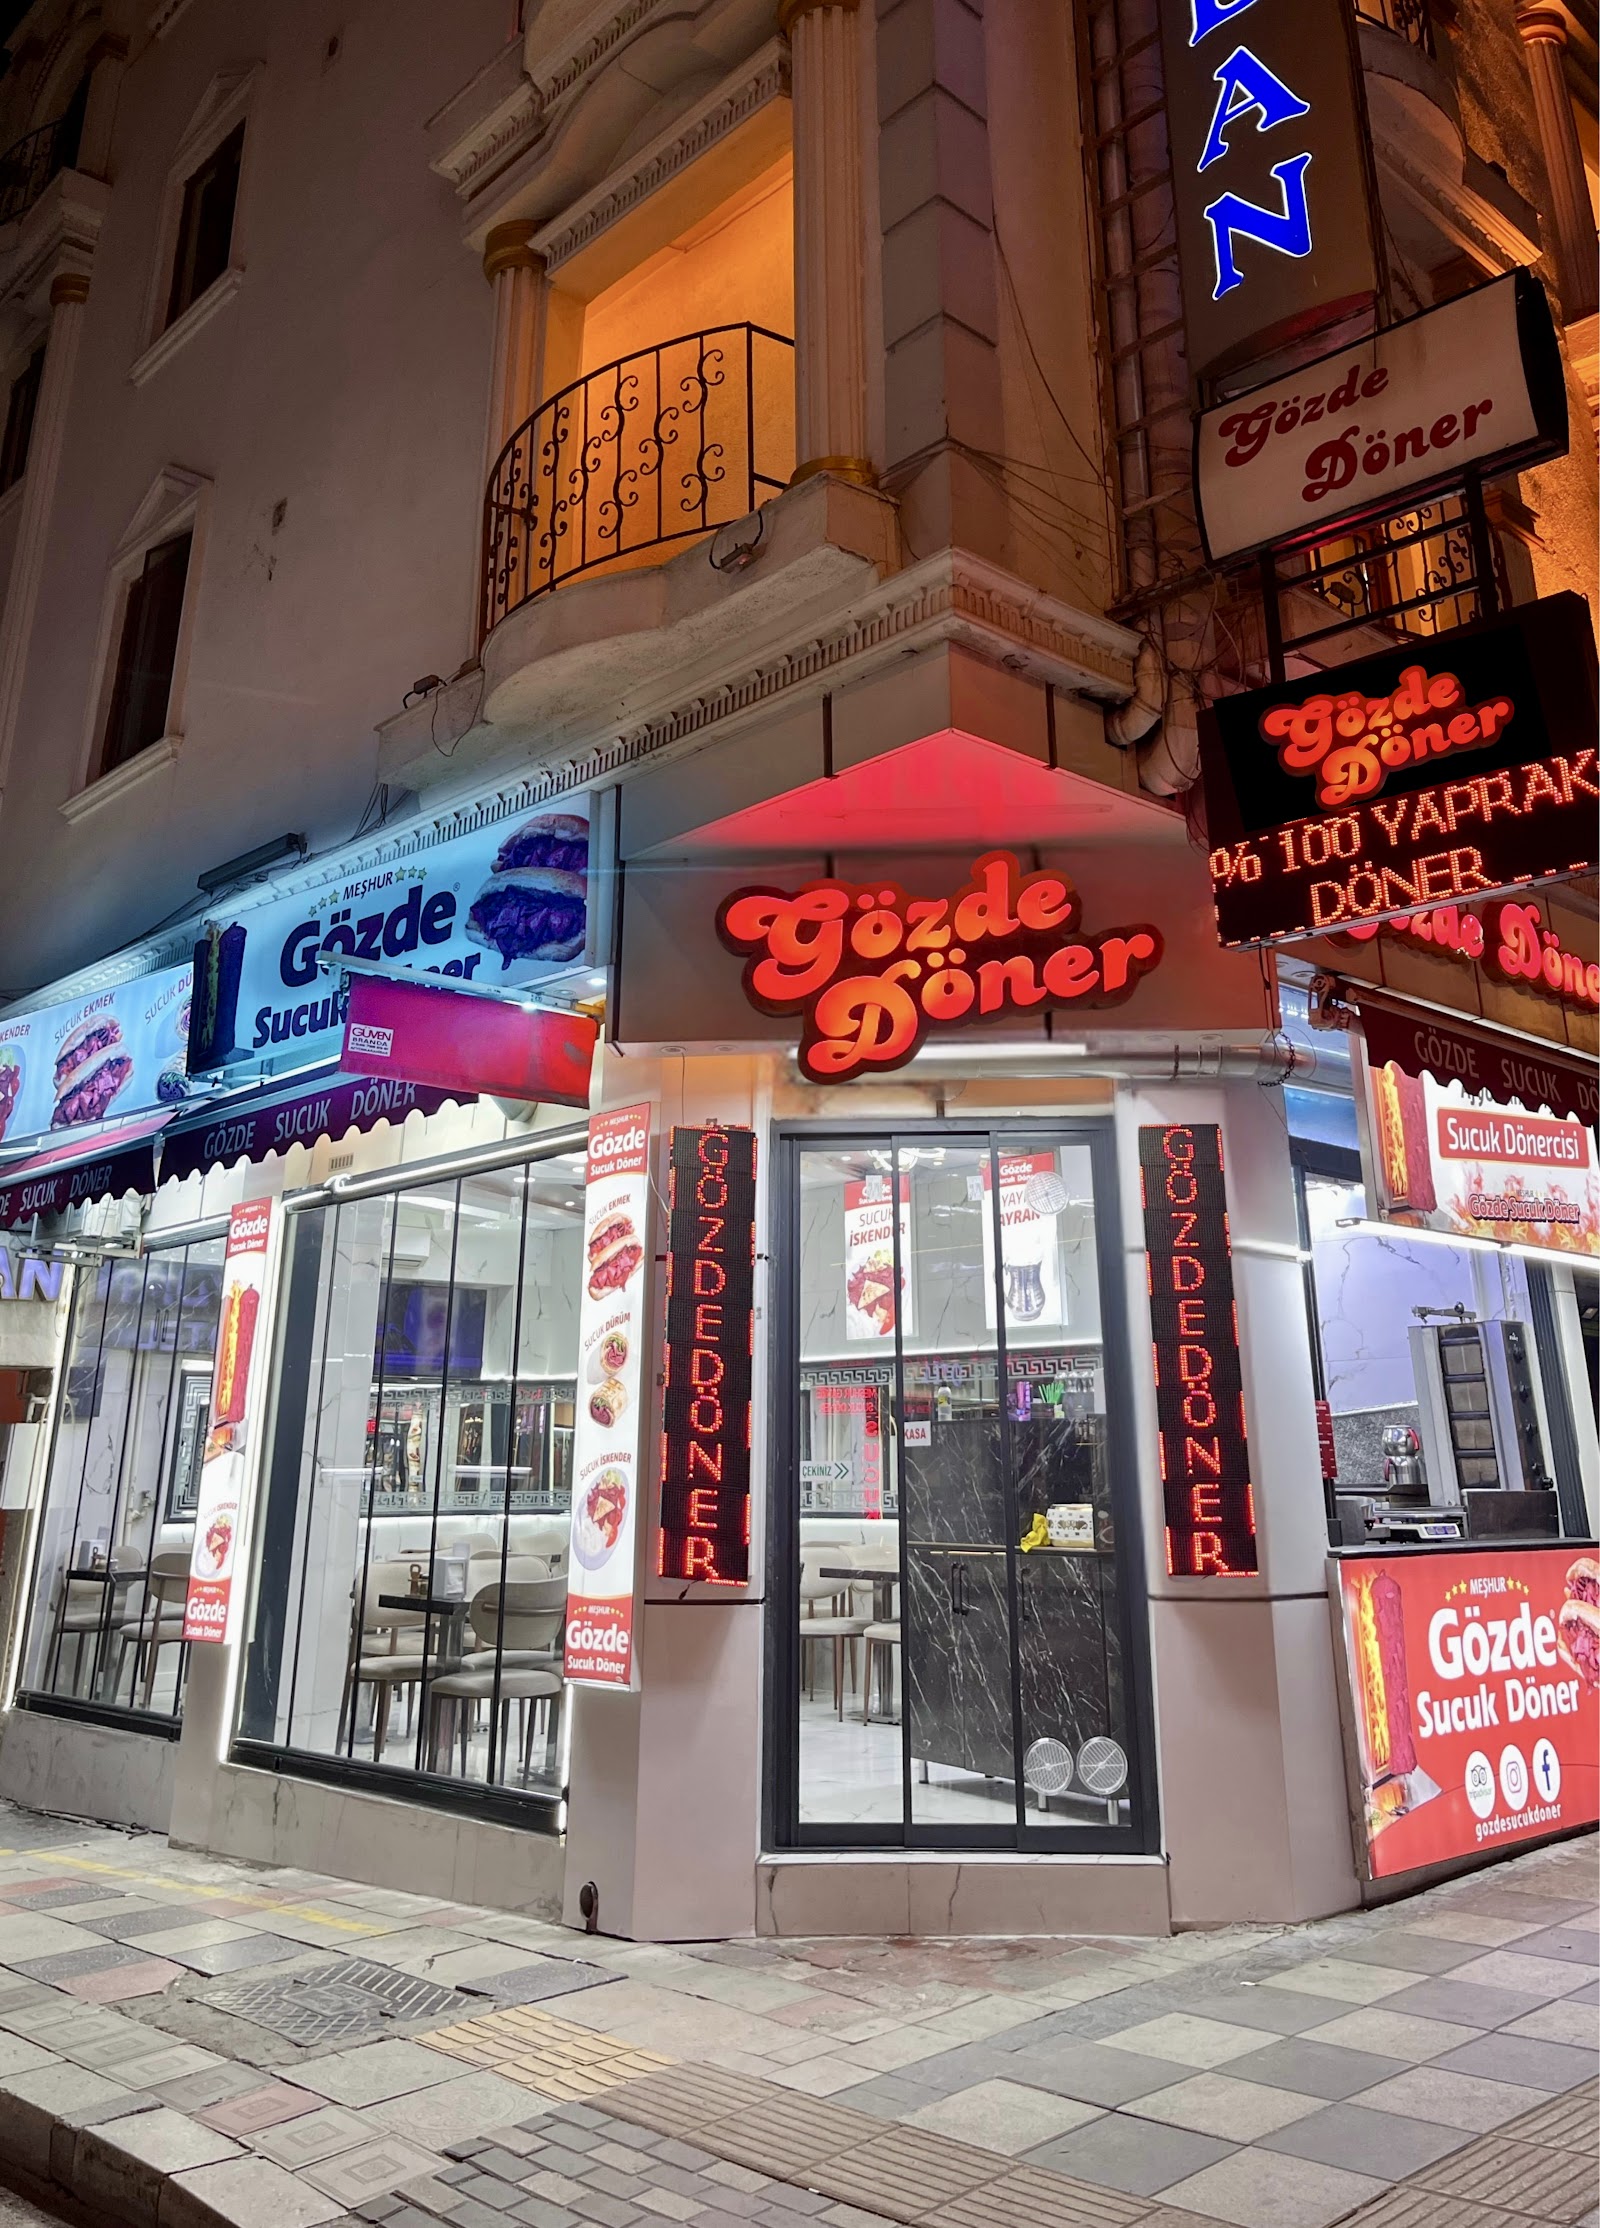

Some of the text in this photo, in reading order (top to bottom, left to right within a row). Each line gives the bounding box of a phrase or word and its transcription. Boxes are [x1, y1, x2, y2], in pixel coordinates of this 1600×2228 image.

[1190, 0, 1312, 300] AN
[1218, 365, 1389, 468] Gözde
[1302, 399, 1493, 503] Döner
[1263, 667, 1460, 768] Gözde
[1319, 700, 1510, 806] Döner
[1278, 812, 1361, 873] 100
[1371, 748, 1599, 847] YAPRAK
[342, 871, 393, 901] MEŞHUR
[1310, 846, 1502, 927] DÖNER
[280, 884, 457, 988] Gözde
[725, 860, 1072, 1001] Gözde
[54, 991, 117, 1045] SUCUK EKMEK
[144, 986, 177, 1025] SUCUK
[253, 990, 349, 1049] Sucuk
[807, 932, 1155, 1074] Döner
[351, 1026, 392, 1042] GÜVEN
[352, 1036, 388, 1047] BRANDA
[1413, 1027, 1480, 1079] GÖZDE
[1500, 1058, 1562, 1103] SUCUK
[203, 1077, 417, 1160] GÖZDE SUCUK DÖNER
[1446, 1117, 1580, 1160] Sucuk Dönercisi
[589, 1126, 646, 1160] Gözde
[590, 1155, 643, 1177] Sucuk Döner
[1000, 1163, 1033, 1176] Gözde
[19, 1177, 60, 1212] SUCUK
[69, 1164, 113, 1199] DÖNER
[608, 1193, 632, 1211] EKMEK
[230, 1214, 268, 1240] Gözde
[1469, 1193, 1581, 1224] Gözde Sucuk Döner
[850, 1221, 906, 1248] İSKENDR
[584, 1311, 631, 1352] SUCUK DÜRÜM
[904, 1428, 926, 1440] KASA
[599, 1452, 632, 1467] İSKENDER
[802, 1464, 832, 1477] ÇEKİNİZ
[1469, 1576, 1507, 1598] MEŞHUR
[187, 1597, 226, 1623] Gözde
[566, 1620, 629, 1655] Gözde
[1428, 1601, 1558, 1681] Gözde
[567, 1655, 626, 1675] Sucuk Döner
[1416, 1676, 1580, 1739] Sucuk Döner
[1475, 1803, 1562, 1843] gozdesucukdoner
